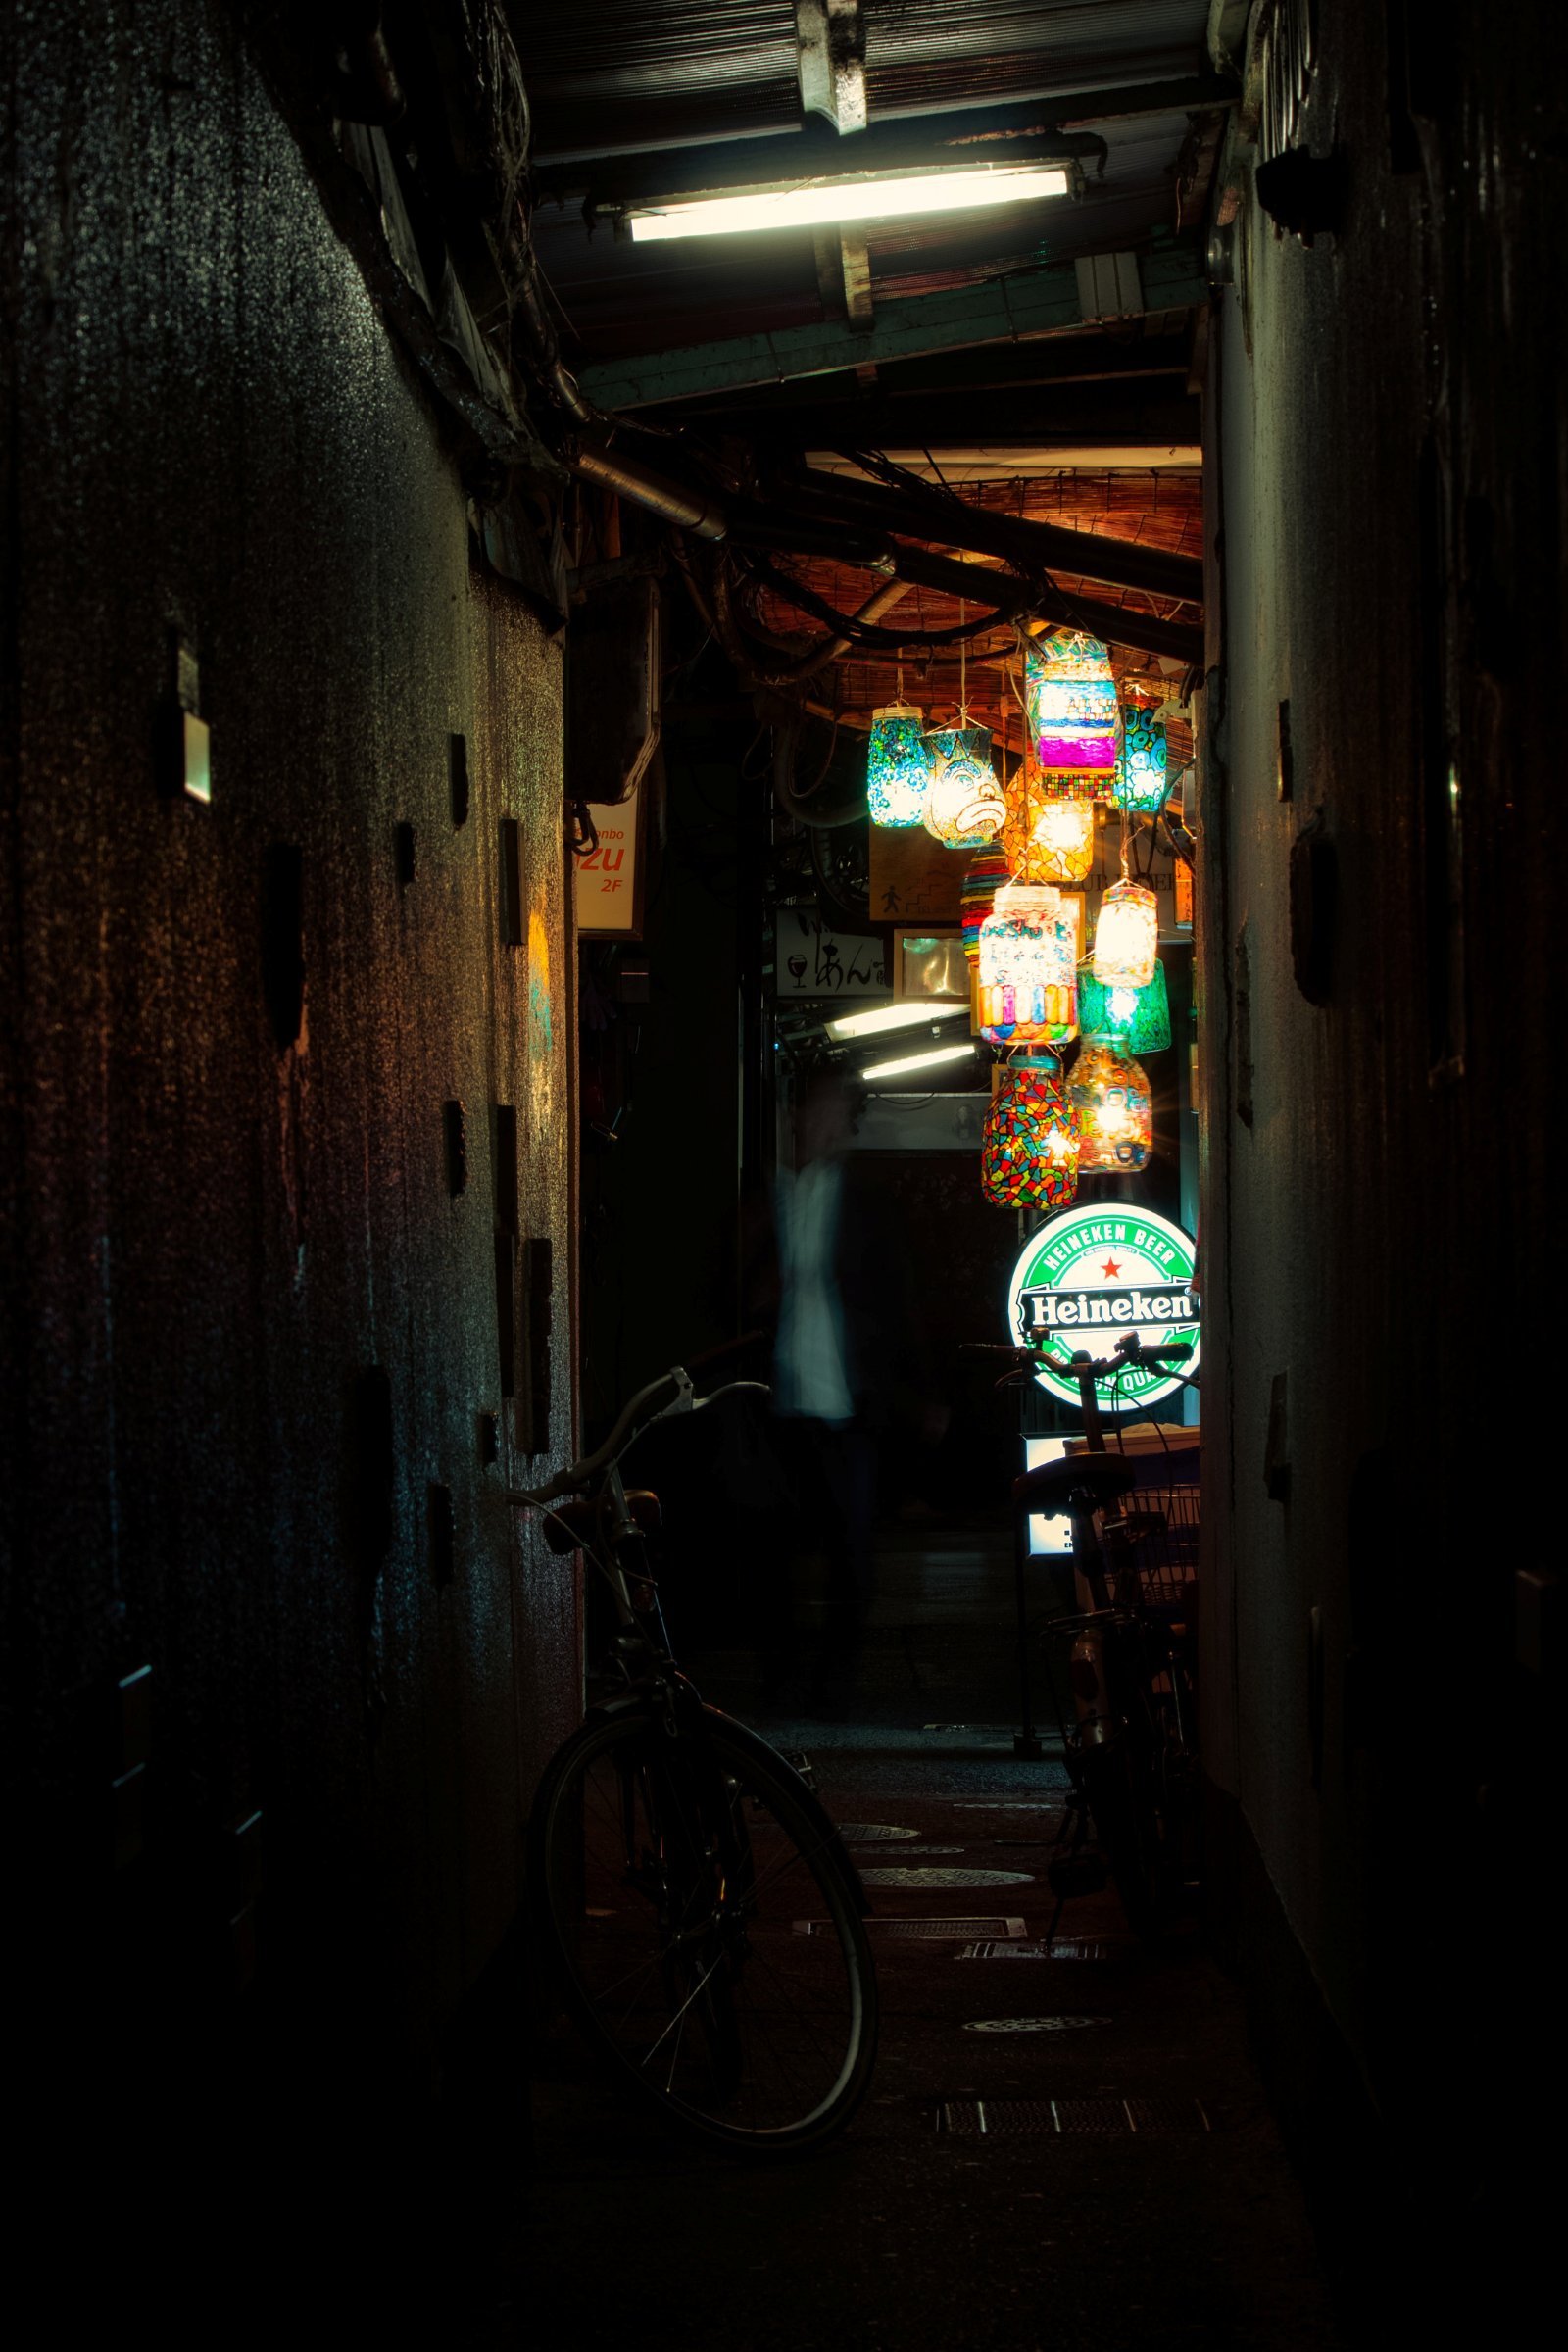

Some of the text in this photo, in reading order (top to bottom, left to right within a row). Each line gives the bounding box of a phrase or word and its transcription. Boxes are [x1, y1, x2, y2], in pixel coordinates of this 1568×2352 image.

[601, 879, 623, 892] 2F
[1043, 1224, 1176, 1271] HEINEKEN BEER
[1031, 1291, 1194, 1325] Heineken
